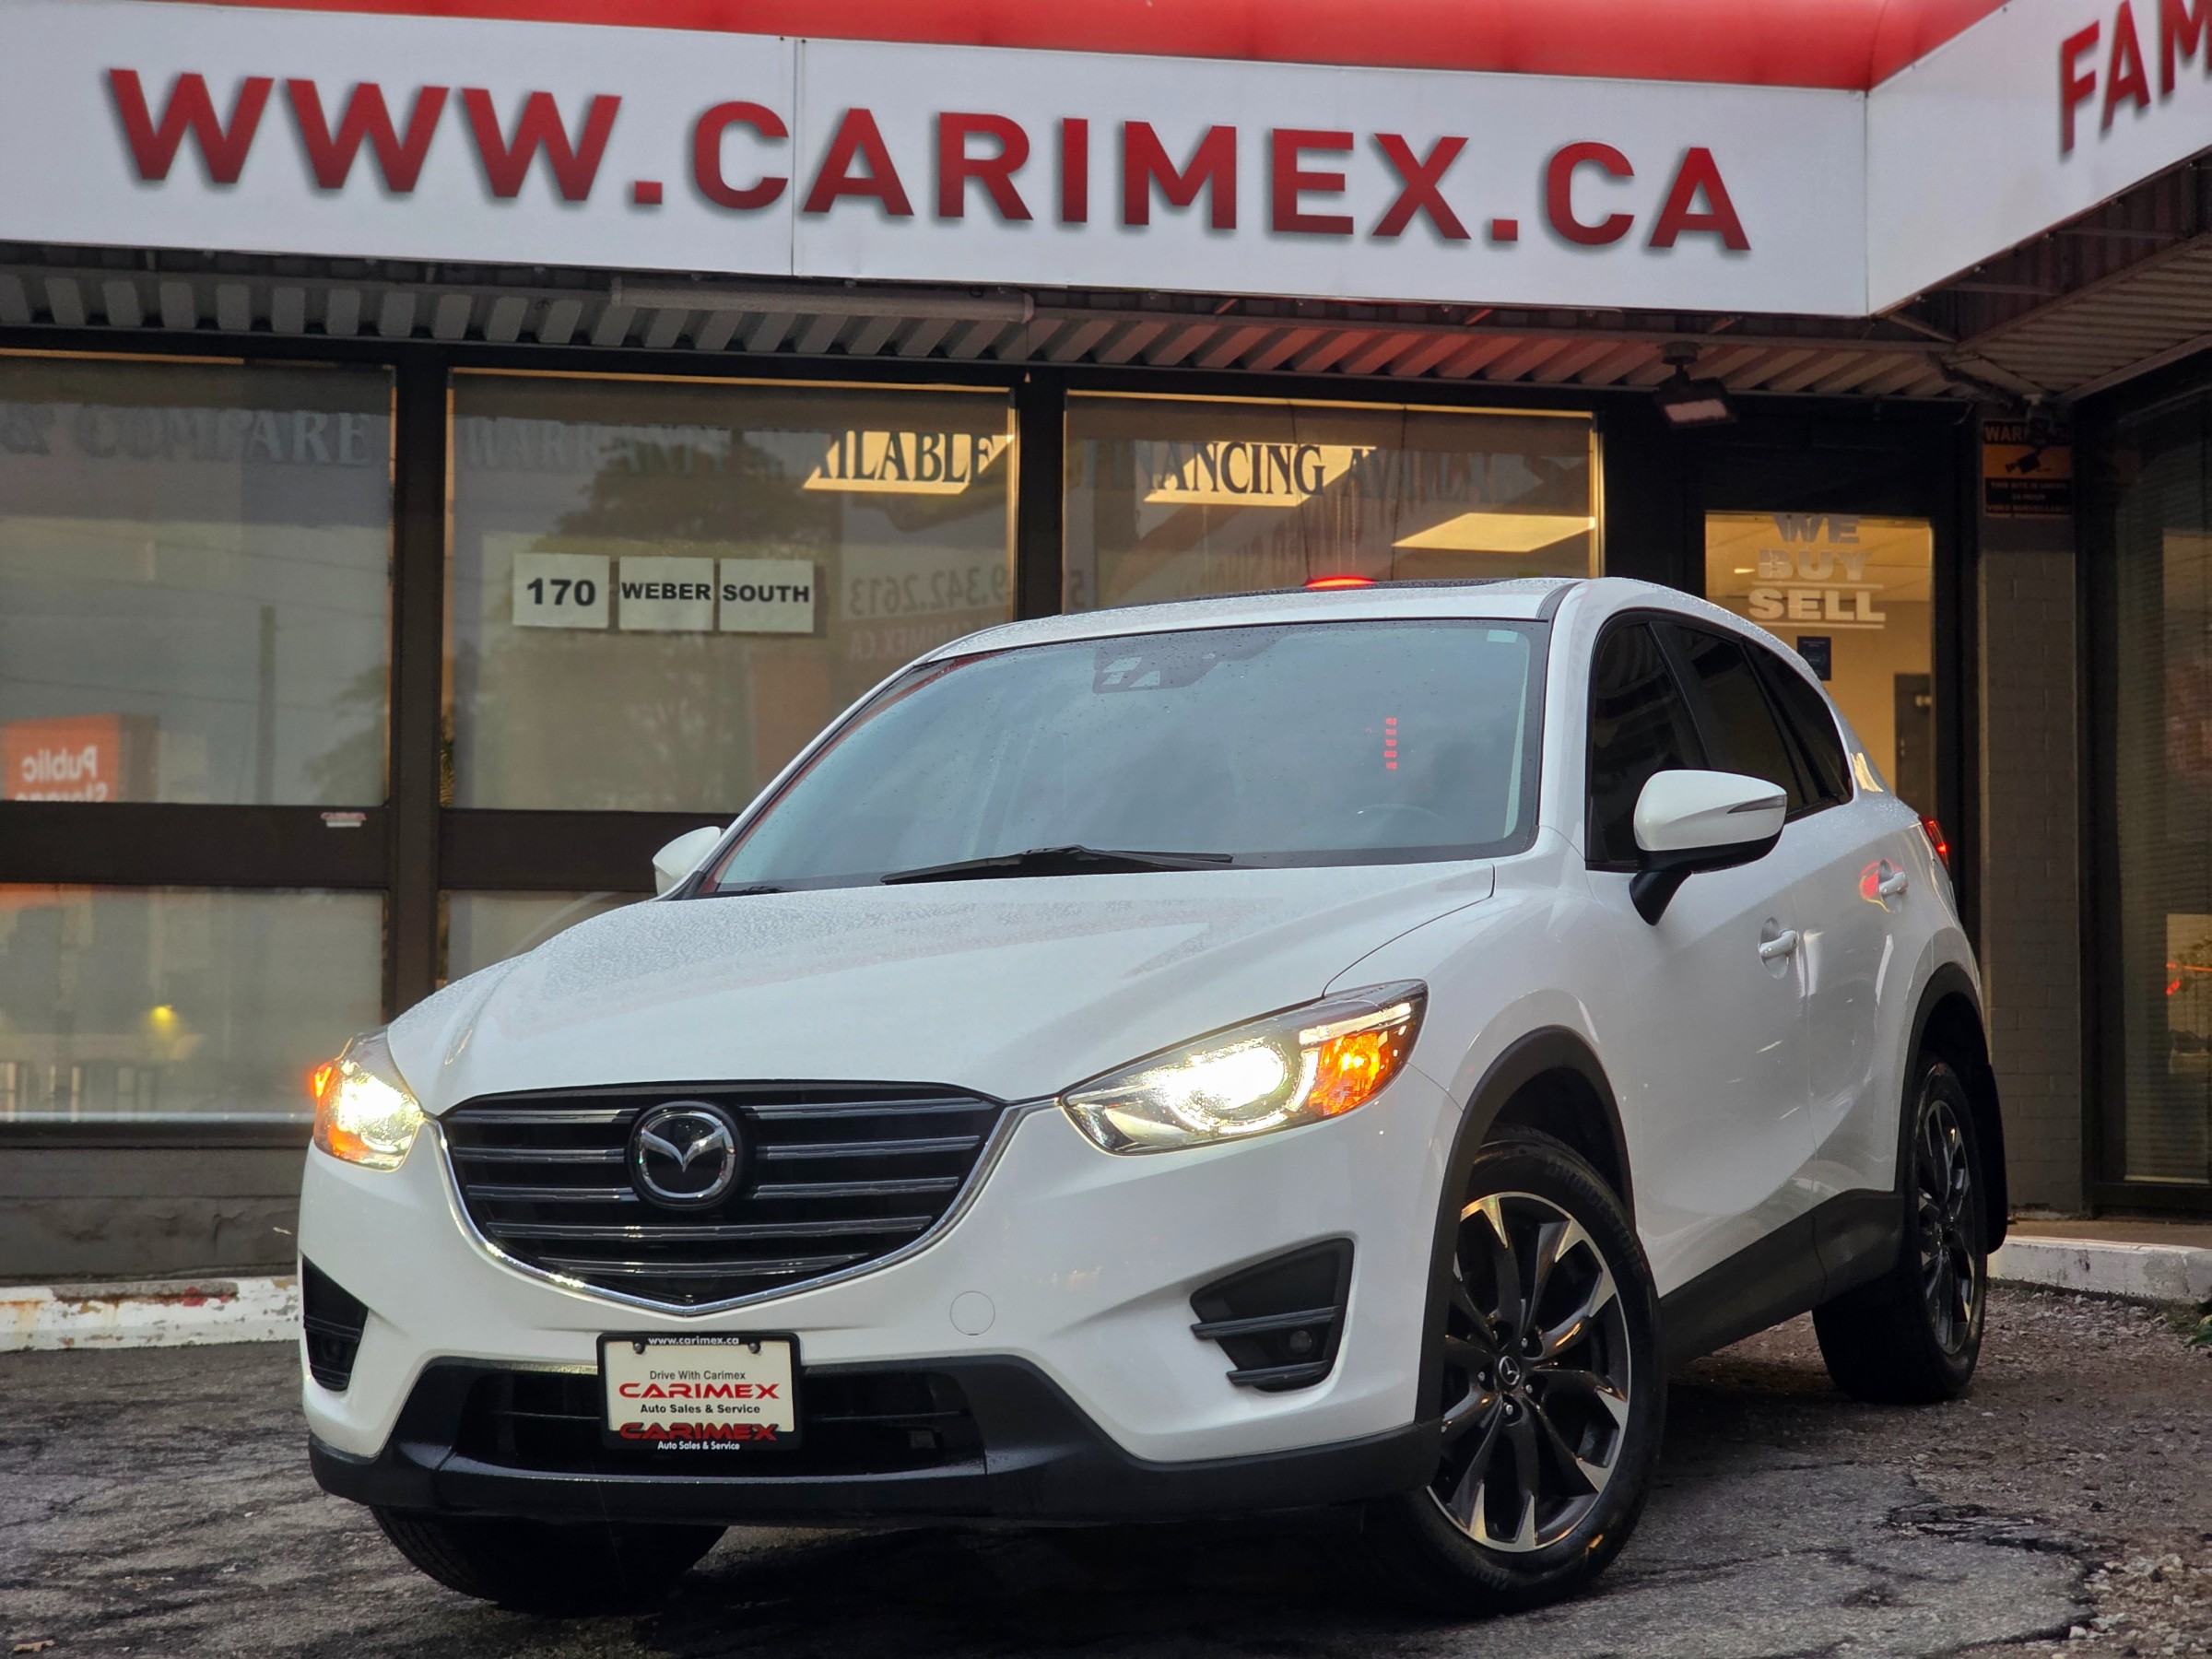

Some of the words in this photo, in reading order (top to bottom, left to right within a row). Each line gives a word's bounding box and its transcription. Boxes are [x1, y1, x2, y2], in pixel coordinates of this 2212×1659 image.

[108, 67, 1752, 252] WWW.CARIMEX.CA
[1772, 514, 1860, 544] WE
[1758, 548, 1873, 582] BUY
[527, 577, 596, 606] 170
[621, 582, 712, 600] WEBER
[722, 584, 810, 603] SOUTH
[1747, 587, 1887, 622] SELL
[648, 1335, 739, 1345] www.carimex.ca
[650, 1371, 676, 1380] Drive
[677, 1371, 700, 1380] With
[703, 1371, 746, 1380] Carimex
[618, 1382, 780, 1399] CARIMEX
[641, 1404, 666, 1414] Auto
[670, 1404, 701, 1414] Sales
[705, 1405, 713, 1414] &
[717, 1405, 760, 1414] Service
[619, 1422, 780, 1441] CARIMEX
[657, 1441, 677, 1450] Auto
[679, 1441, 700, 1450] Sales
[702, 1441, 709, 1450] &
[711, 1441, 740, 1451] Service
